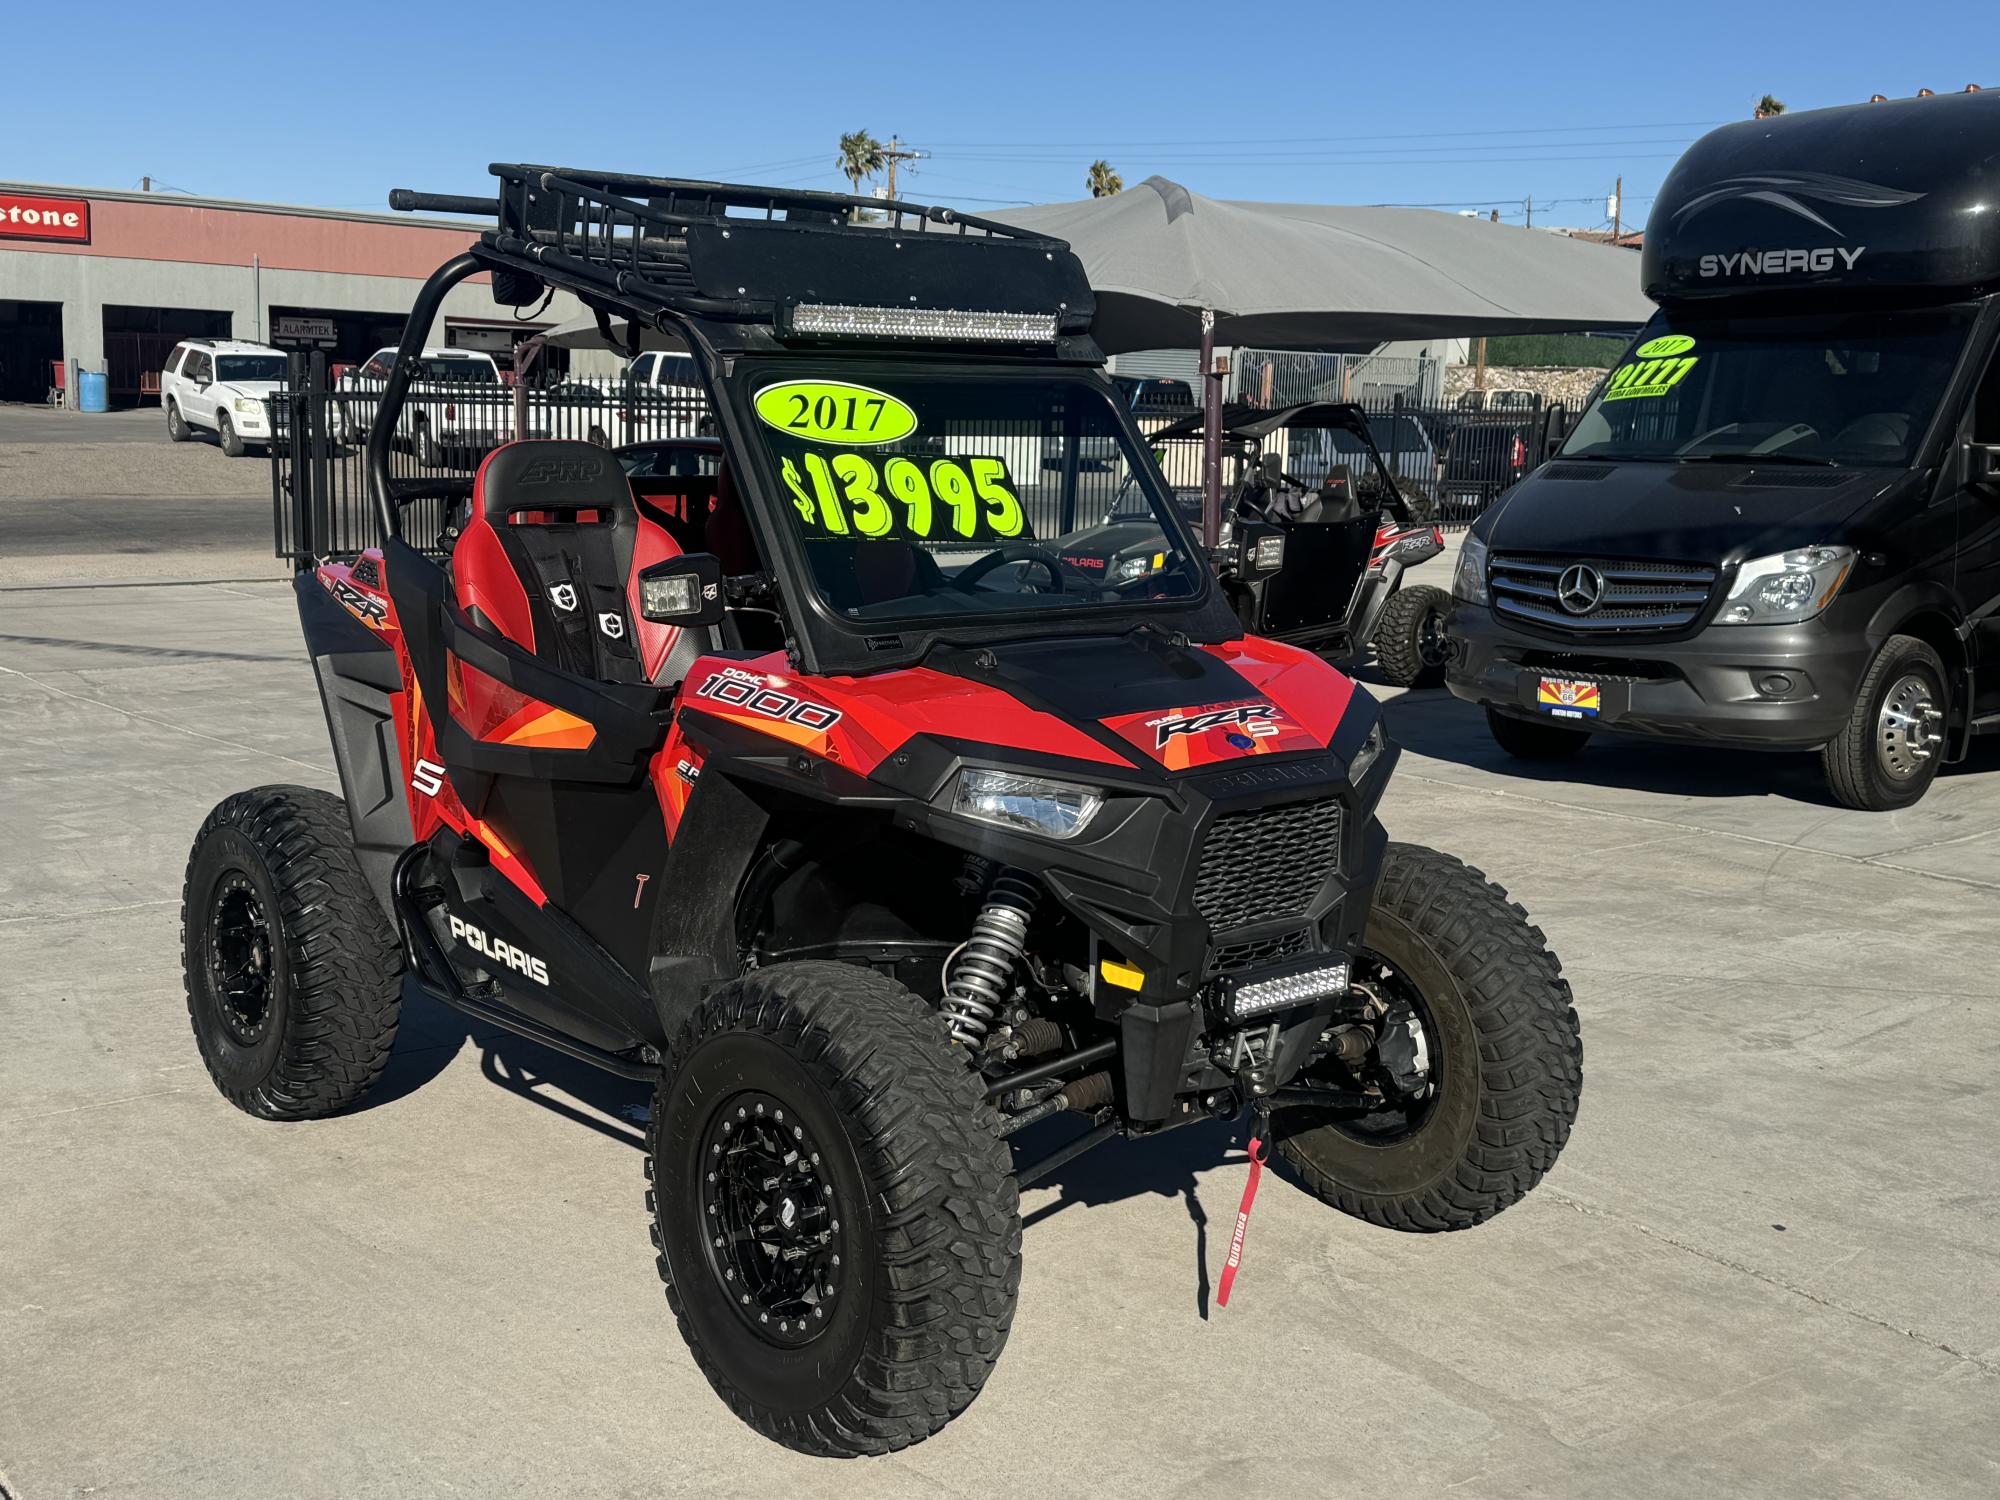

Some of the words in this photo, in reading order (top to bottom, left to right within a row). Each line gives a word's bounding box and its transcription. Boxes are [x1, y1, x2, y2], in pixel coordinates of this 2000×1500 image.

[1700, 246, 1866, 277] SYNERGY
[283, 323, 330, 336] ALARMTEK
[1642, 339, 1688, 354] 2017
[787, 394, 886, 432] 2017
[781, 453, 1023, 538] $13995
[330, 577, 388, 631] RZR
[722, 667, 767, 686] DOHC
[696, 673, 843, 732] 1000
[1144, 714, 1184, 727] POLARIS
[1156, 704, 1284, 750] RZR
[1247, 721, 1280, 738] S
[411, 758, 446, 797] S
[450, 914, 549, 986] POLARIS
